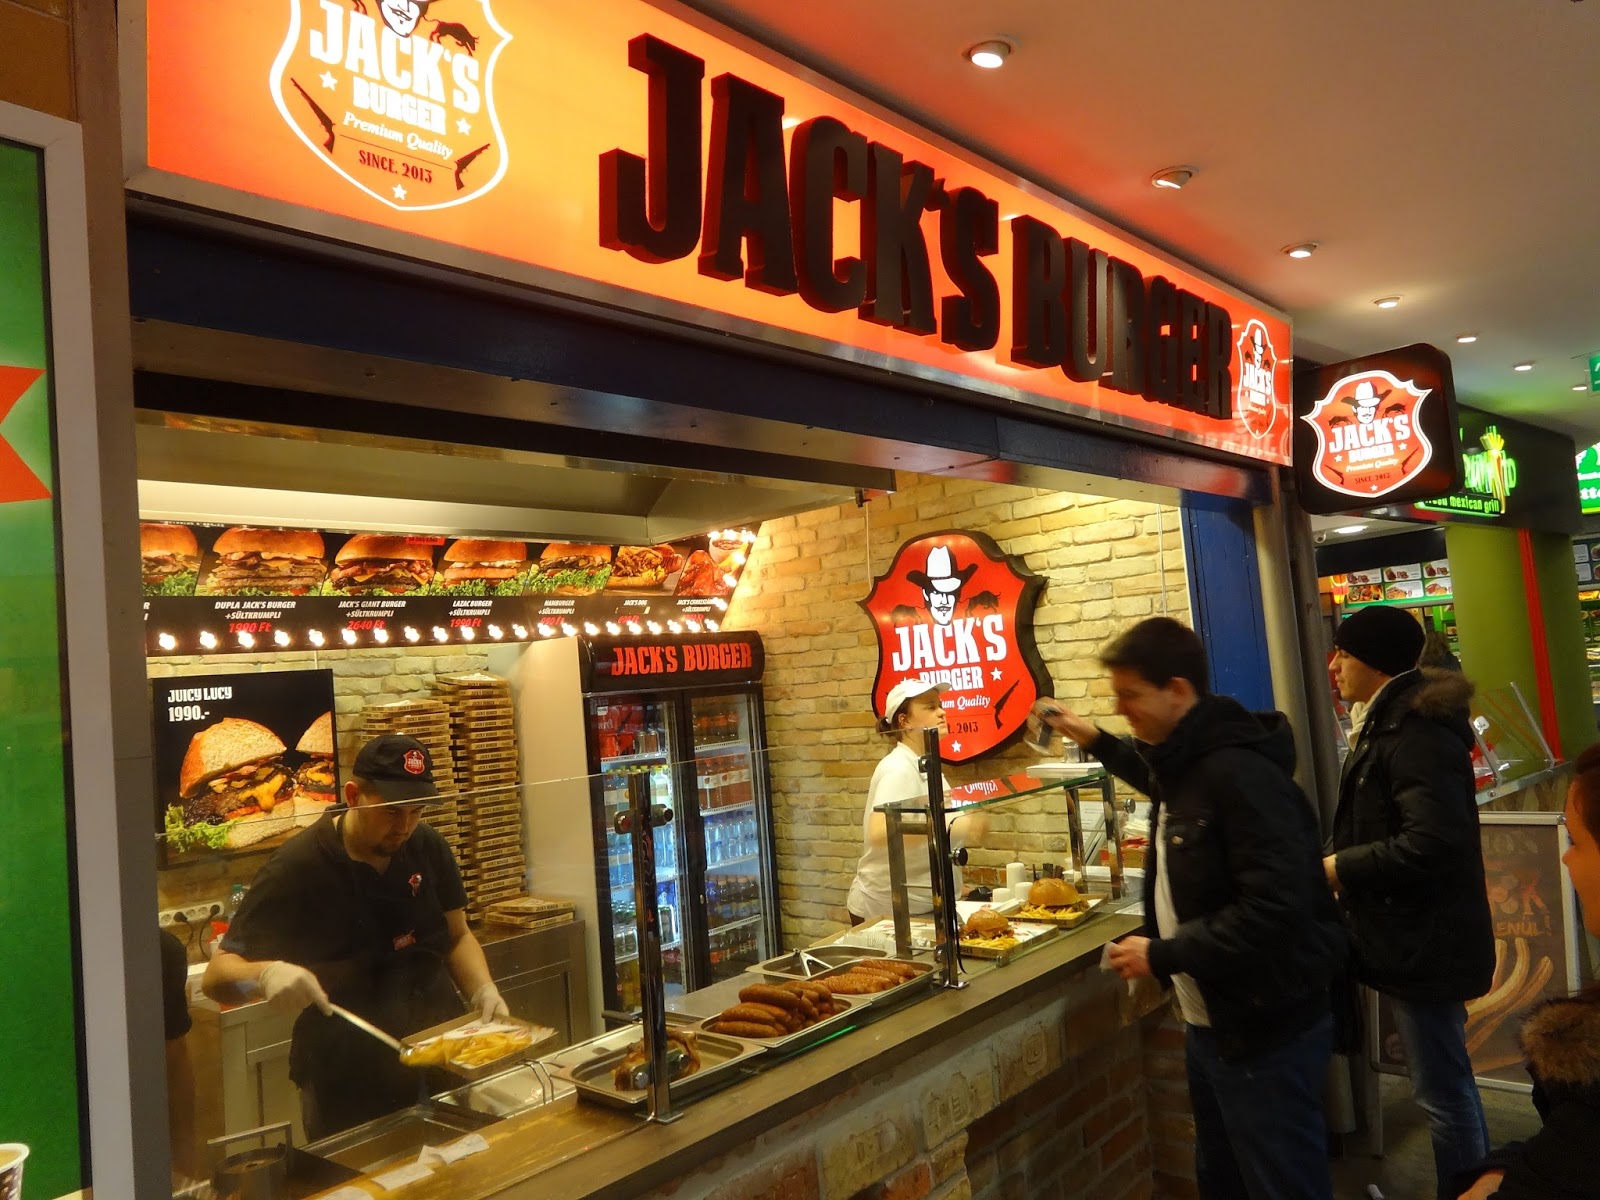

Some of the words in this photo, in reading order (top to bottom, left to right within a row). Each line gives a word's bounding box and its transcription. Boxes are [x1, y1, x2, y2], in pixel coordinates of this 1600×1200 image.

[309, 0, 481, 115] JACK'S
[352, 76, 447, 136] BURGER
[342, 111, 404, 143] Premium
[406, 132, 453, 160] Quality
[401, 163, 433, 185] 2013
[599, 33, 1001, 352] JACK'S
[1010, 214, 1234, 419] BURGER
[1328, 414, 1411, 454] JACK'S
[214, 601, 240, 609] DUPLA
[241, 601, 267, 609] JACK'S
[266, 601, 296, 609] BURGER
[338, 600, 360, 608] JACK'S
[361, 600, 381, 608] GIANT
[380, 600, 407, 608] BURGER
[225, 611, 282, 620] +SÜLTKRUMPLI
[345, 609, 395, 618] +SÜLTKRUMPLI
[229, 622, 255, 633] 1990
[257, 622, 272, 632] Ft
[373, 619, 386, 630] Ft
[892, 613, 1007, 672] JACK'S
[611, 645, 679, 676] JACK'S
[682, 642, 753, 672] BURGER
[167, 689, 201, 703] JUICY
[203, 686, 233, 701] LUCY
[957, 694, 991, 710] Quality
[956, 721, 979, 734] 2013
